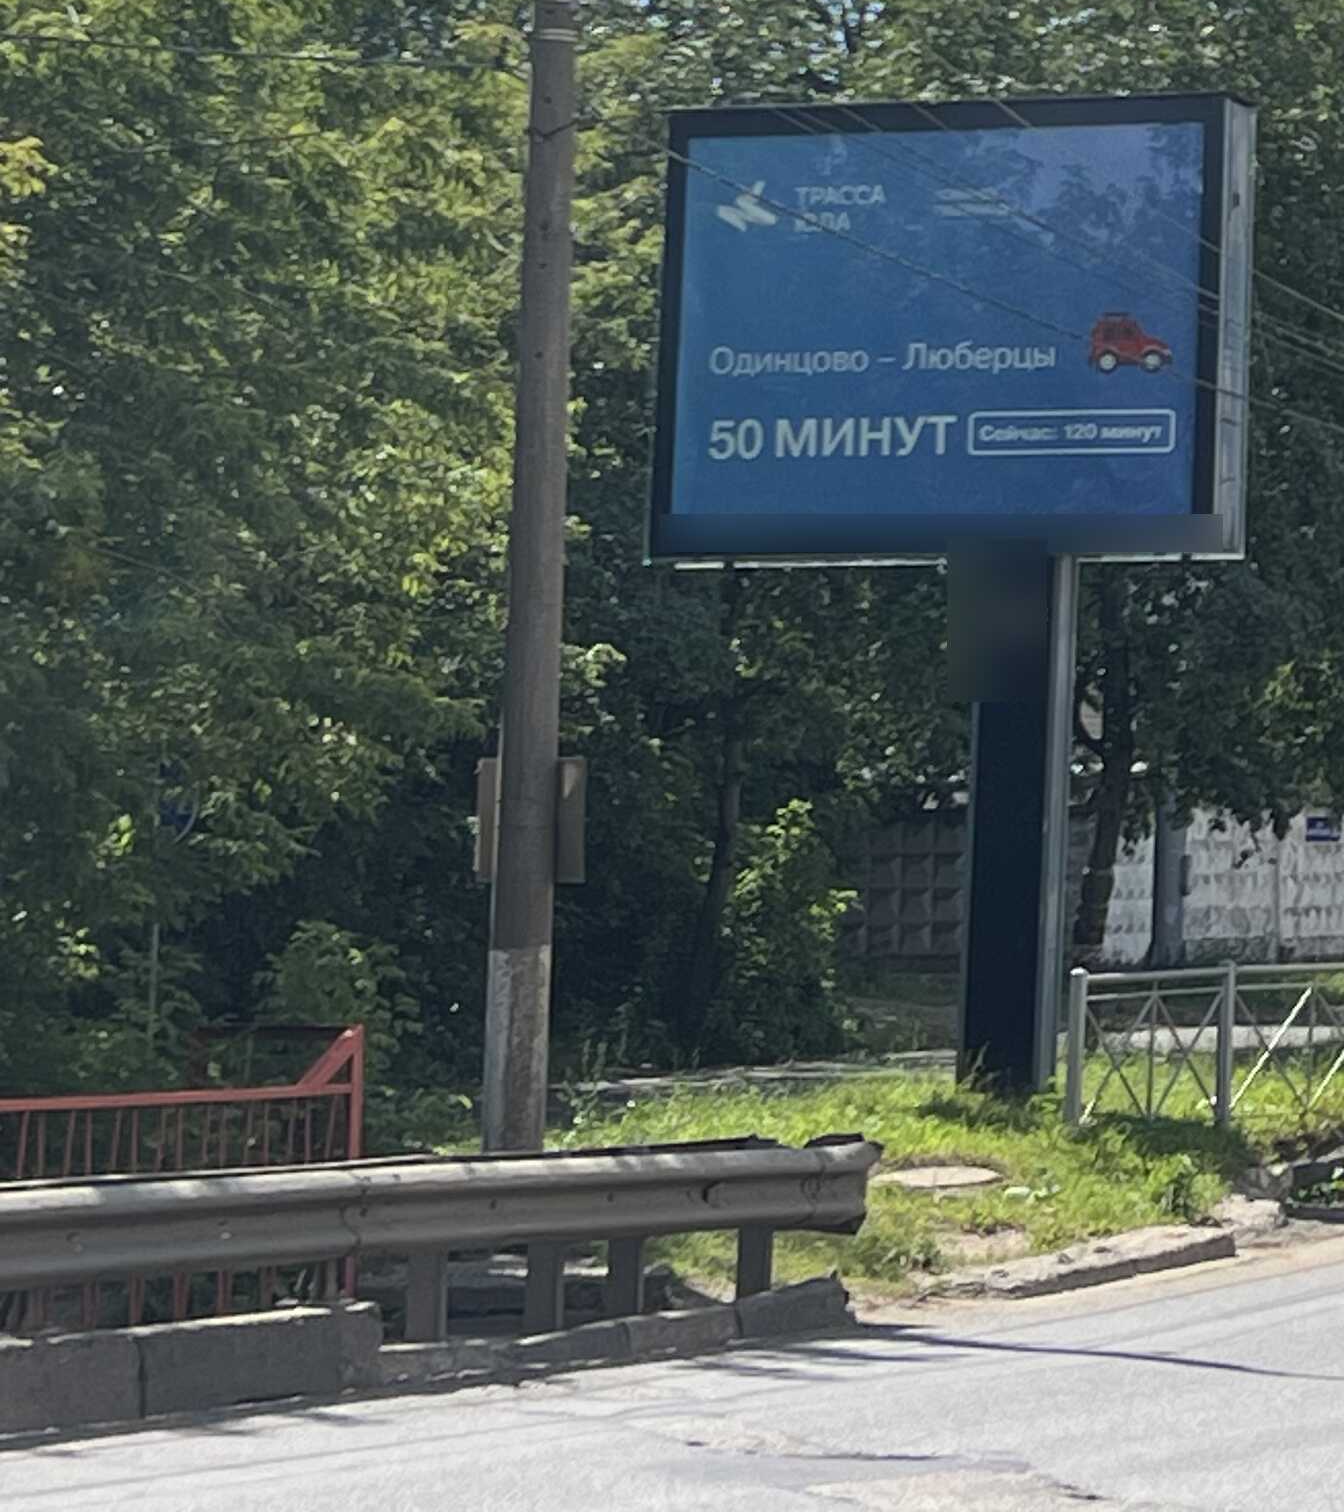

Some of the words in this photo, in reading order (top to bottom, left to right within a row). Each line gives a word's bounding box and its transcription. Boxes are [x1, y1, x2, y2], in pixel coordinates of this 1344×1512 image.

[795, 185, 887, 206] ТРАССА
[709, 345, 869, 377] Одинцово
[902, 339, 1057, 375] Люберцы
[708, 417, 764, 460] 50
[774, 414, 958, 457] МИНУТ
[1063, 423, 1098, 440] 120
